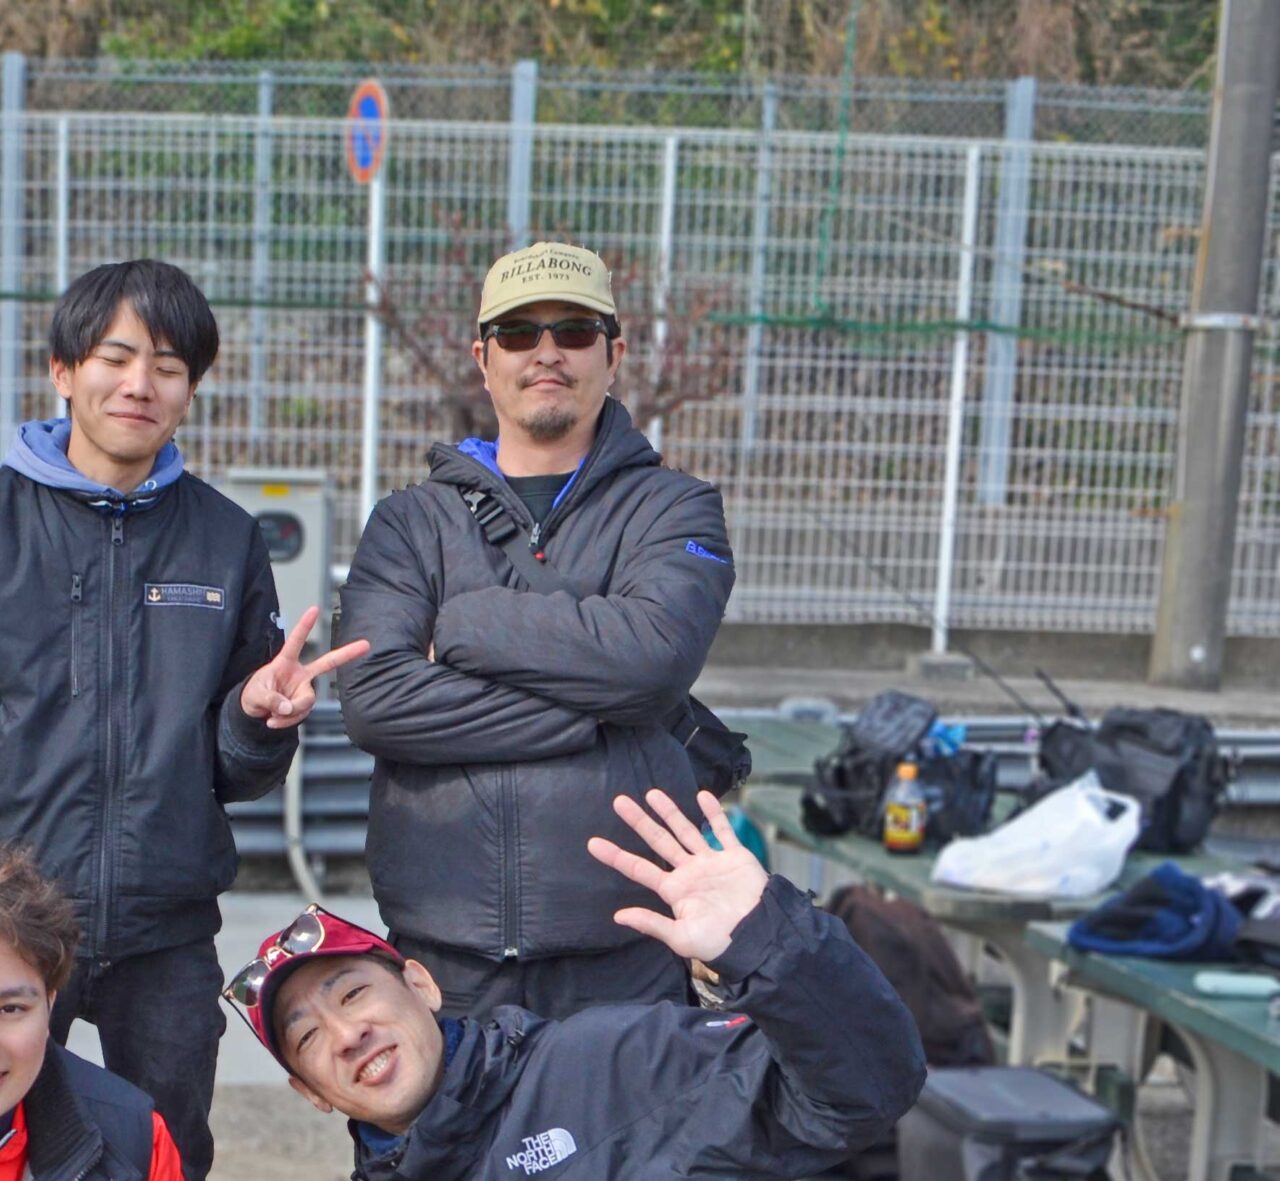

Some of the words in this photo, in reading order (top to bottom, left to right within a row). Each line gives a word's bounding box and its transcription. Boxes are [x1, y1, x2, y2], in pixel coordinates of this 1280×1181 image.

[500, 257, 593, 283] BILLABONG
[521, 1131, 551, 1151] THE
[506, 1142, 556, 1170] NORTH
[523, 1154, 557, 1175] FACE
